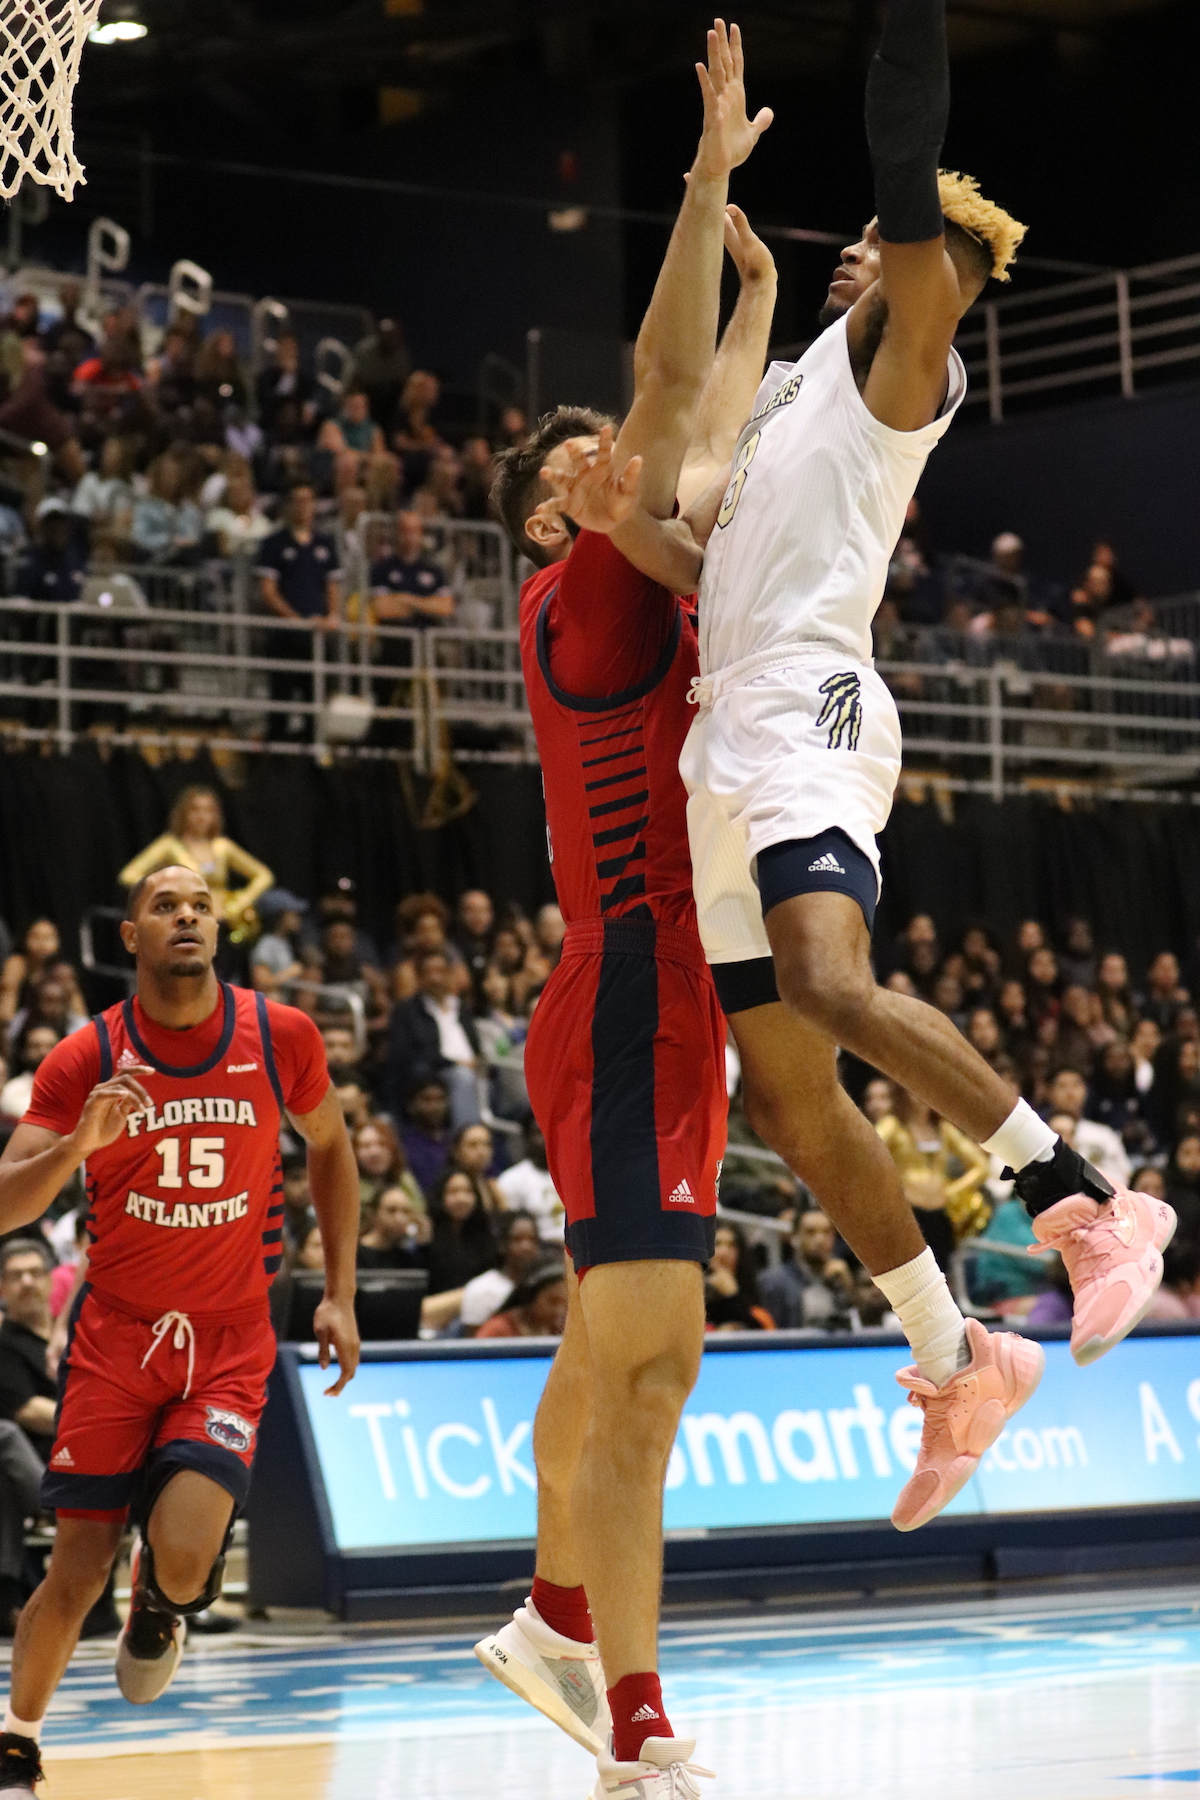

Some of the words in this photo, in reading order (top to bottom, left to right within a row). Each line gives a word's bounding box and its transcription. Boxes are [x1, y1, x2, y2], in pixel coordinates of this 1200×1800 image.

[808, 864, 846, 874] adidas
[126, 1097, 257, 1138] FLORIDA
[154, 1136, 226, 1189] 15
[124, 1190, 249, 1229] ATLANTIC
[668, 1194, 695, 1204] adidas
[209, 1408, 254, 1439] FAU
[1138, 1380, 1186, 1465] A
[631, 1711, 660, 1722] adidas
